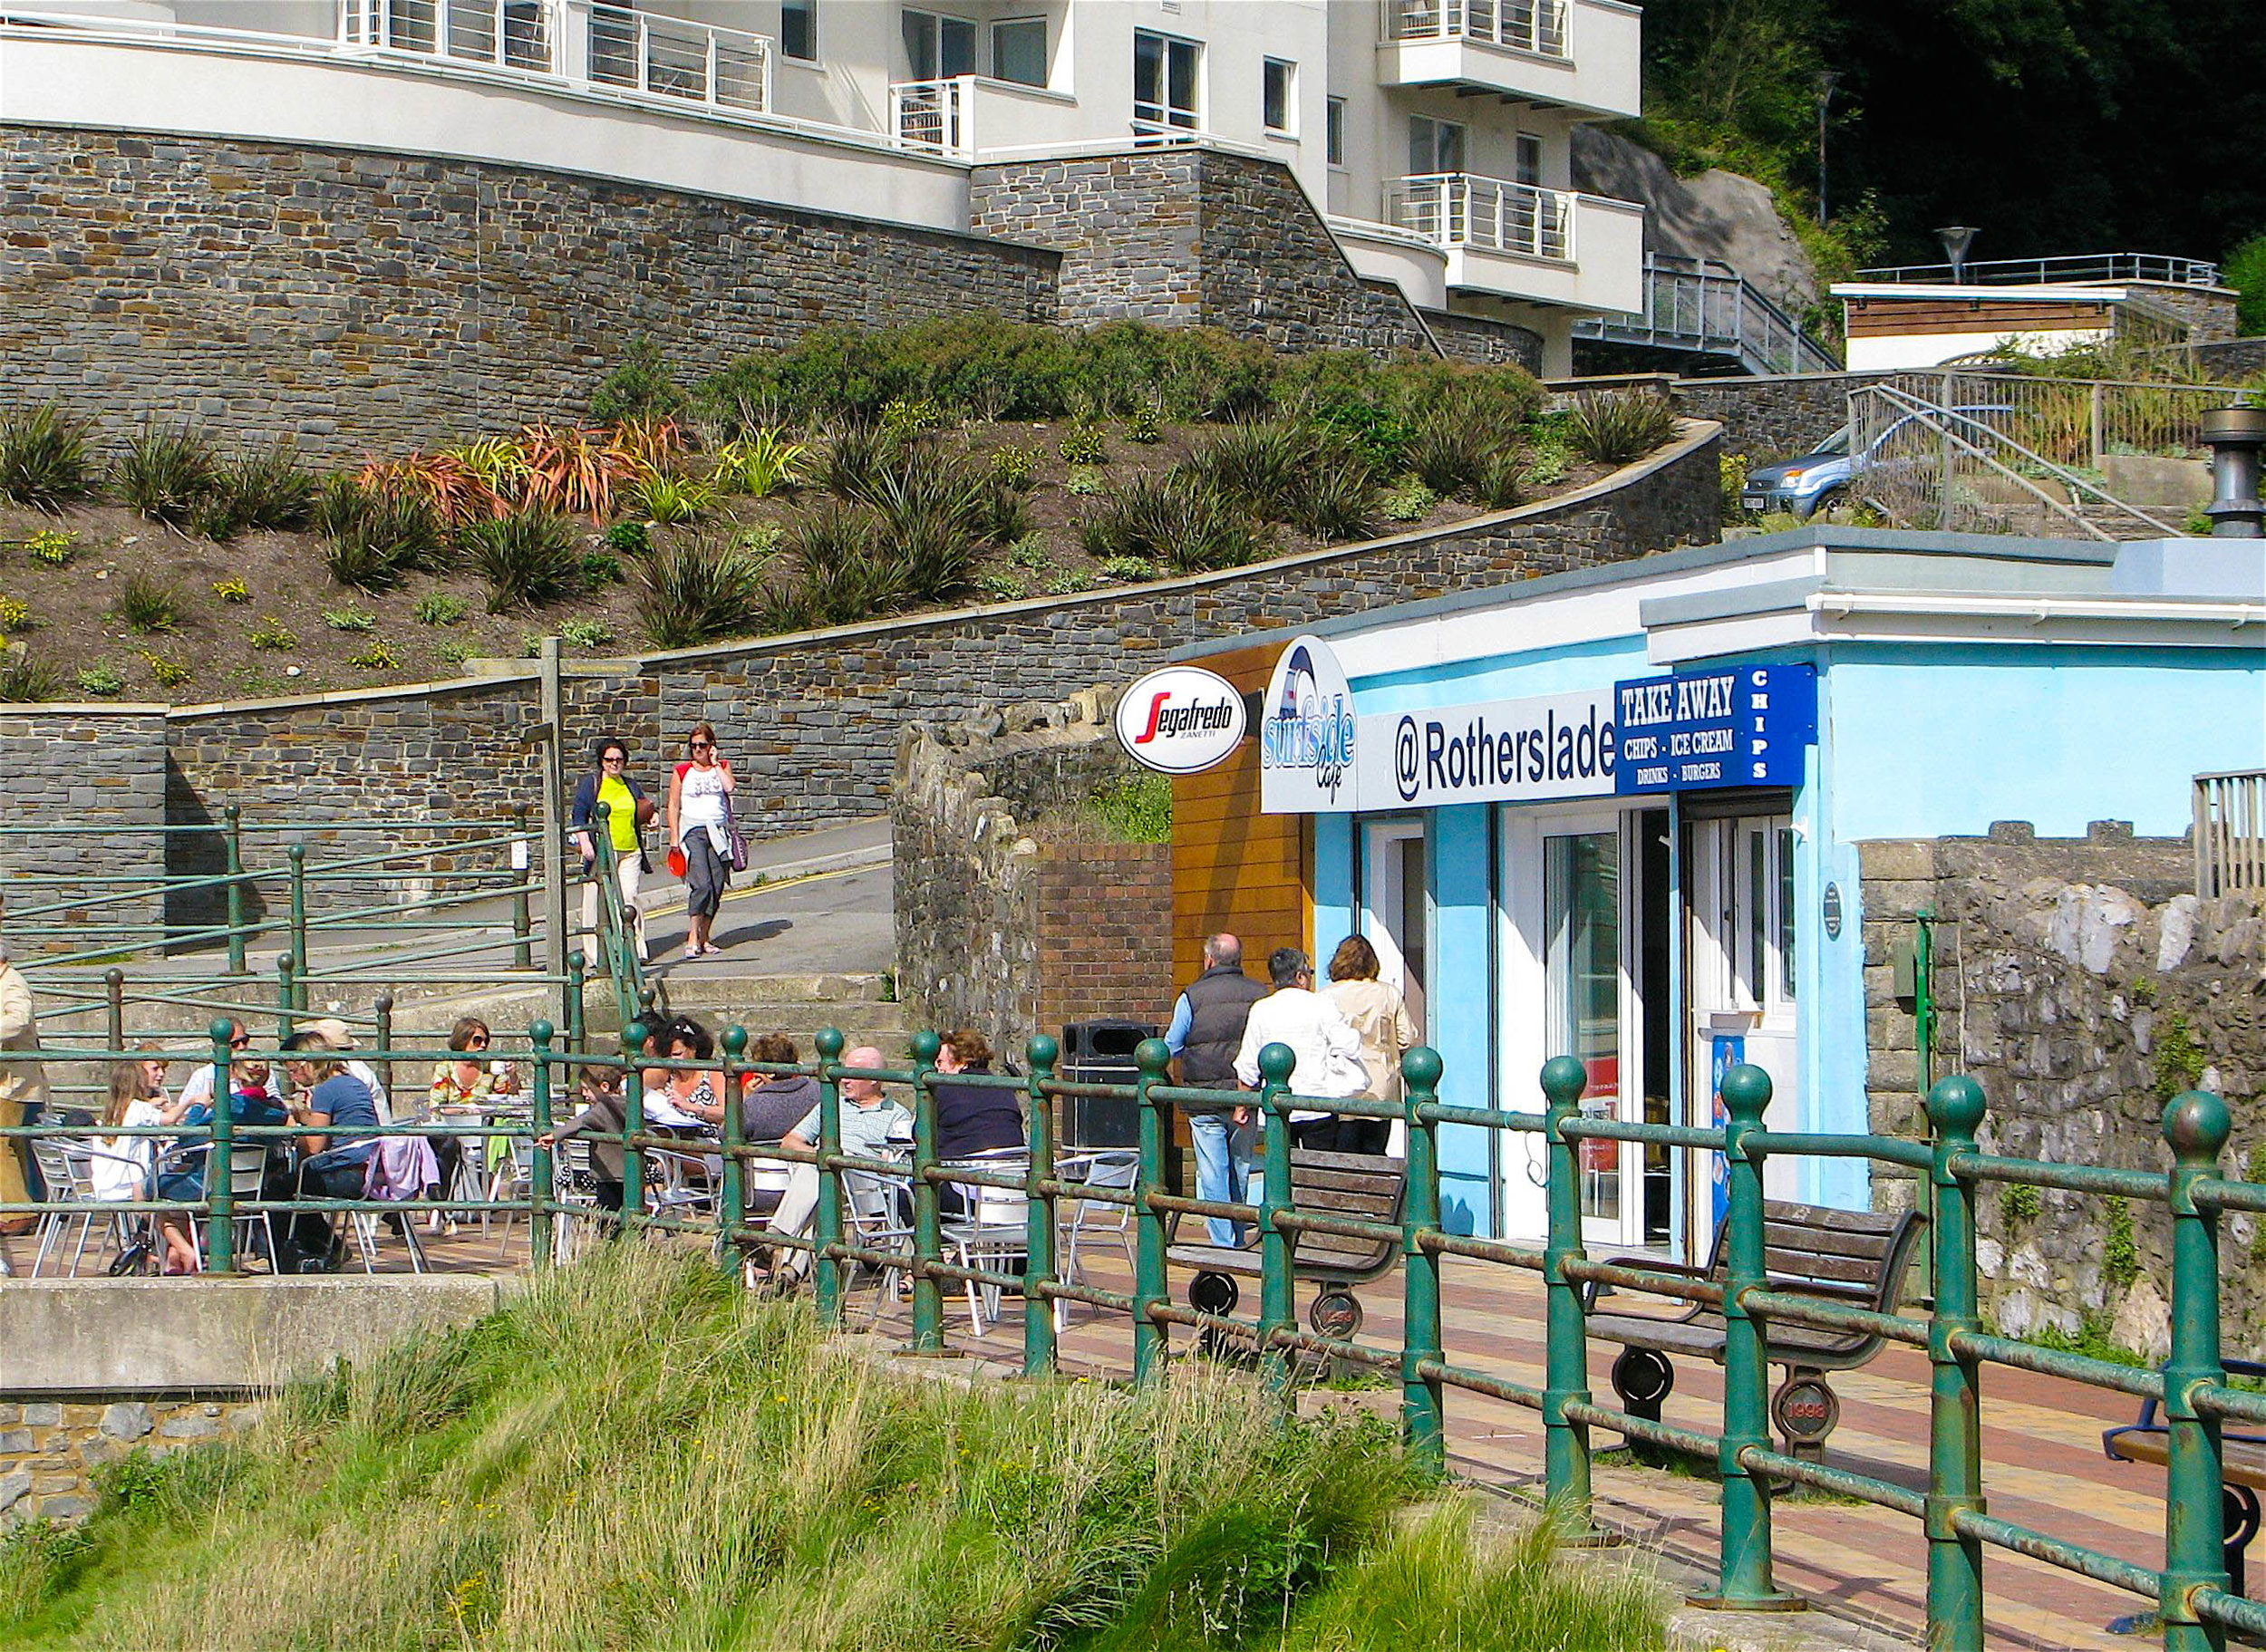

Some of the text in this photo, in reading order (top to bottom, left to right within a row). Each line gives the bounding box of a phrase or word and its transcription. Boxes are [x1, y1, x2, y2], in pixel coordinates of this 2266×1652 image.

[1134, 691, 1233, 744] Segafredo
[1622, 675, 1735, 728] TAKE AWAY
[1750, 670, 1769, 779] CHIPS
[1180, 729, 1215, 739] ZANETTI
[1263, 693, 1354, 769] surfside
[1623, 728, 1734, 761] CHIPS ICE CREAM
[1636, 761, 1722, 786] DRINKS BURGERS
